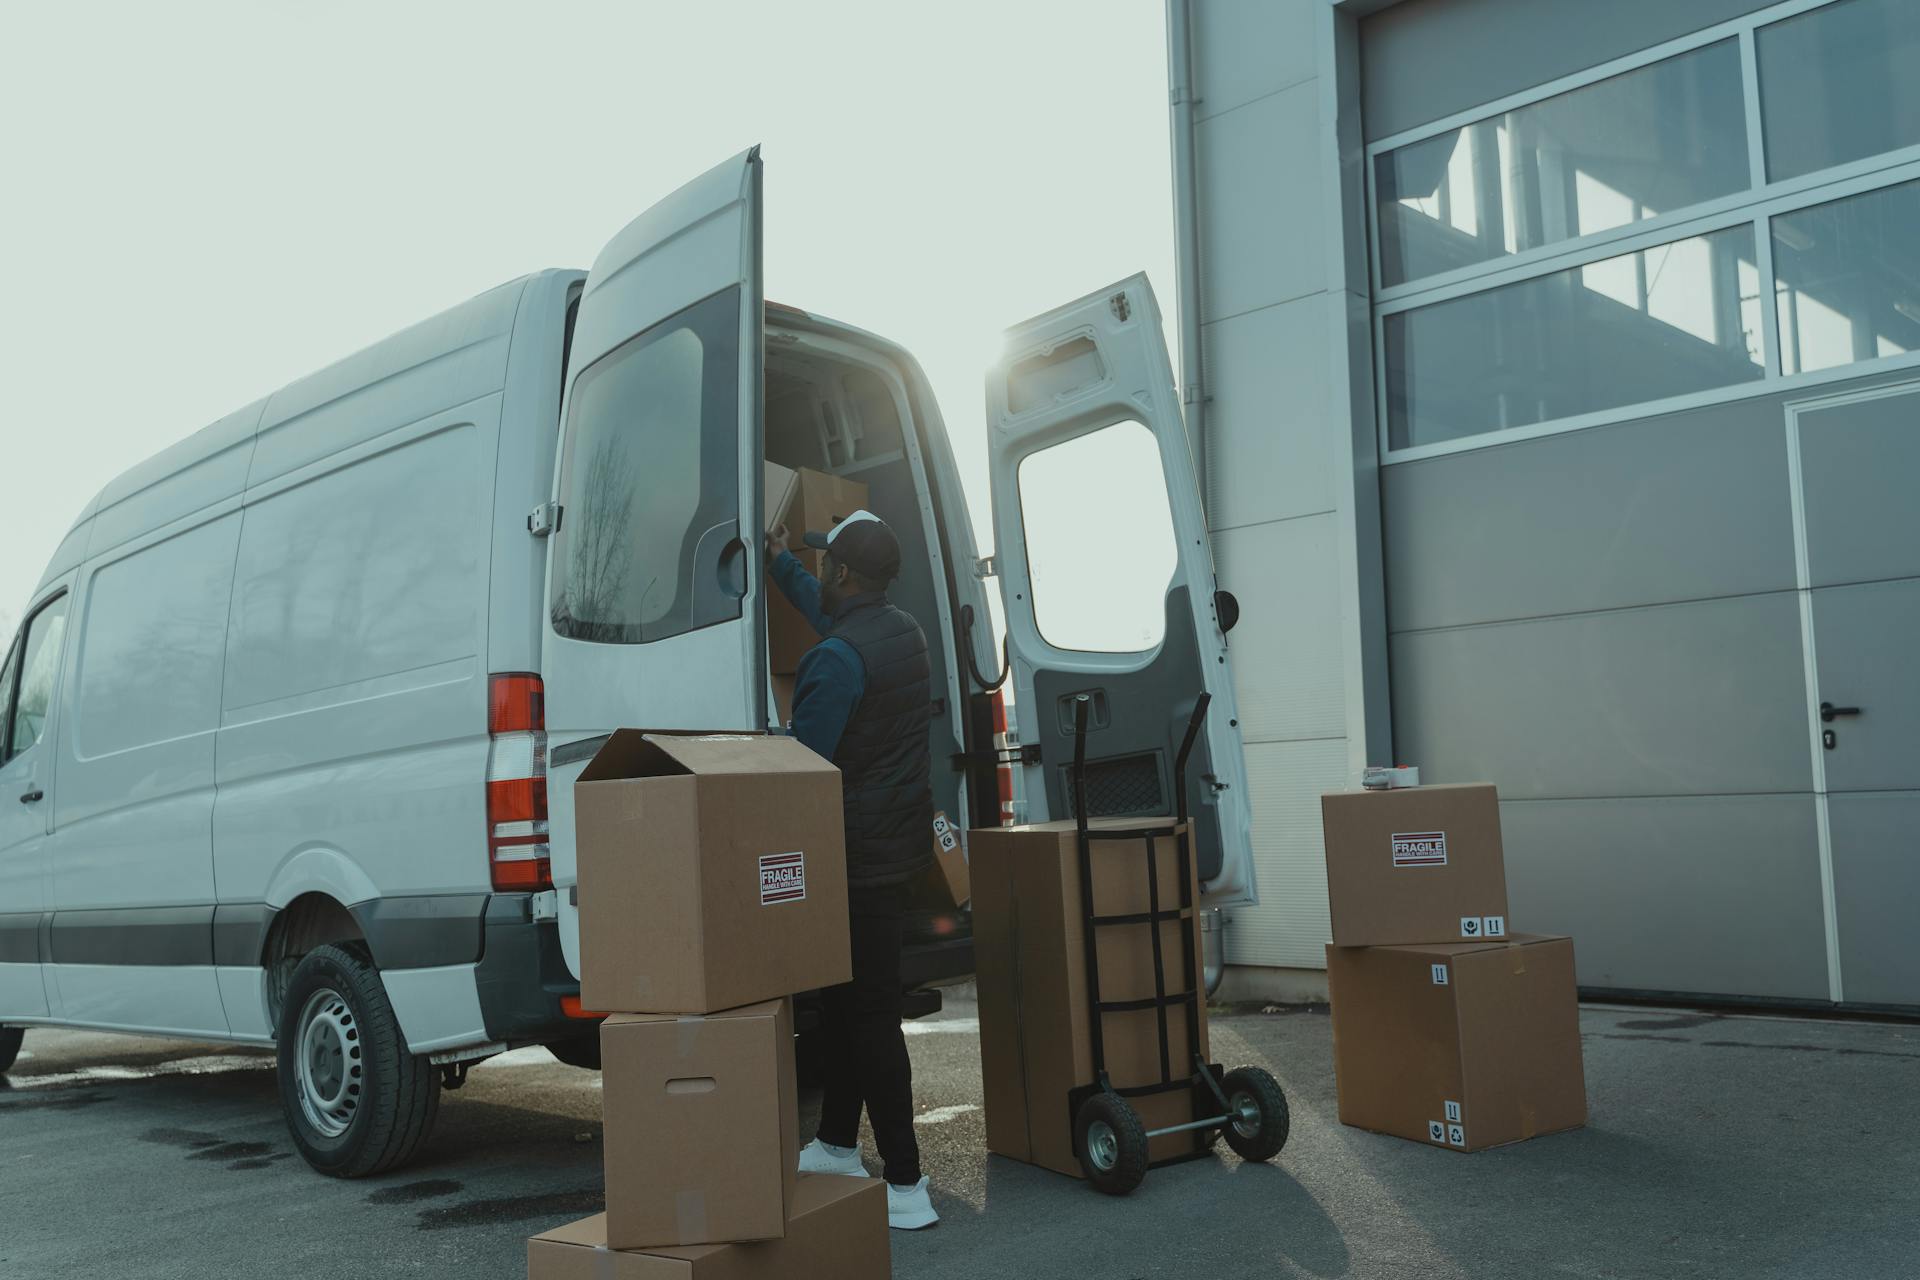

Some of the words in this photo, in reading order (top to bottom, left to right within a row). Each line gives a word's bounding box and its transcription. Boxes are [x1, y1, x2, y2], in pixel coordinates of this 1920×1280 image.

[1395, 841, 1442, 852] FRAGILE
[762, 866, 802, 884] FRAGILE
[763, 882, 779, 890] HANDLE
[791, 879, 802, 887] CARE
